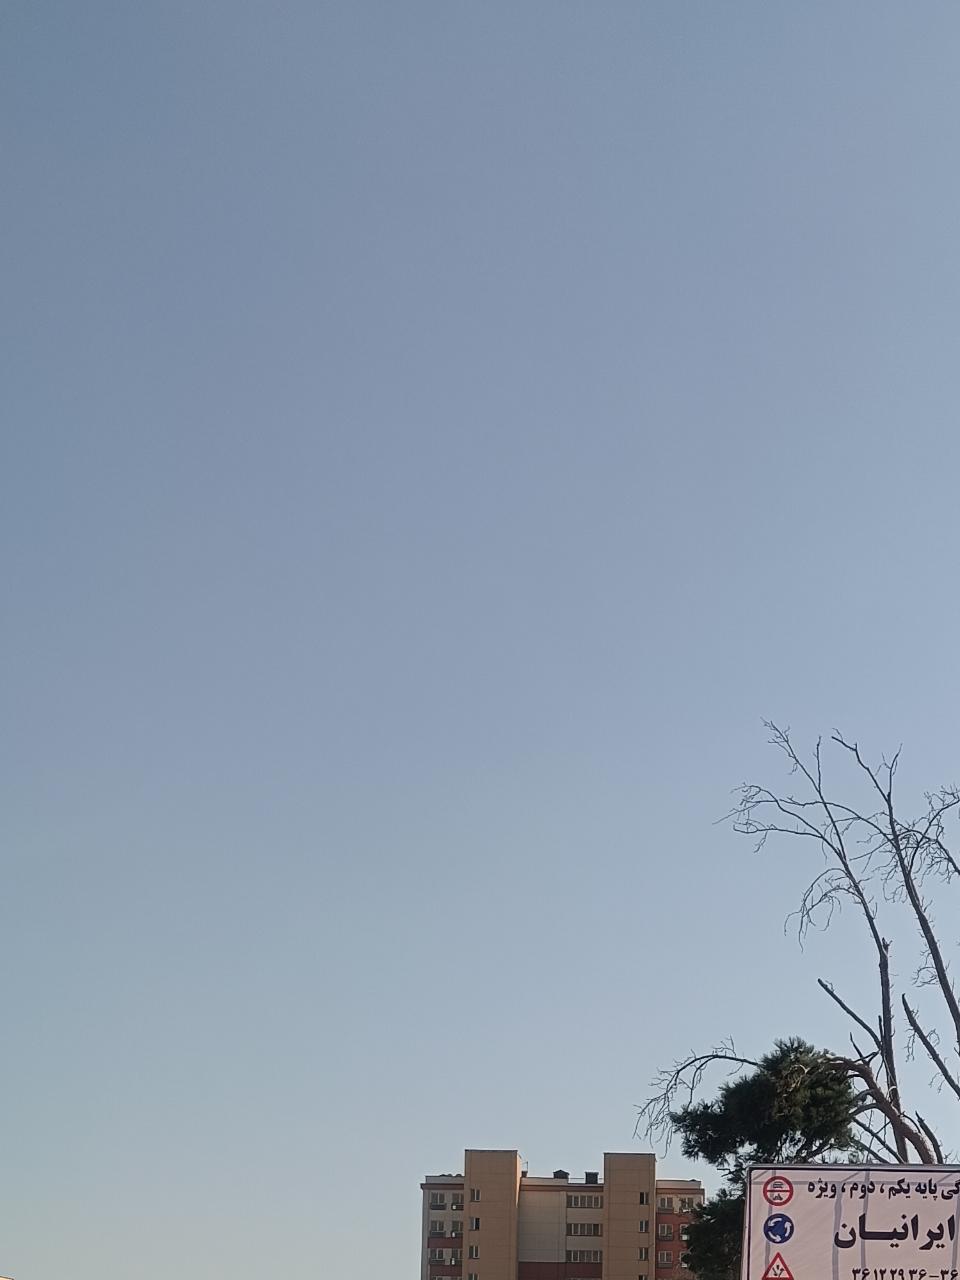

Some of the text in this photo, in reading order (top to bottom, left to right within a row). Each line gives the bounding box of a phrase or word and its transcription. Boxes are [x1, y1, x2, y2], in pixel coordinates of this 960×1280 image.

[807, 1178, 837, 1199] ویژه
[914, 1178, 938, 1201] پایه
[833, 1212, 956, 1251] ایرانیان
